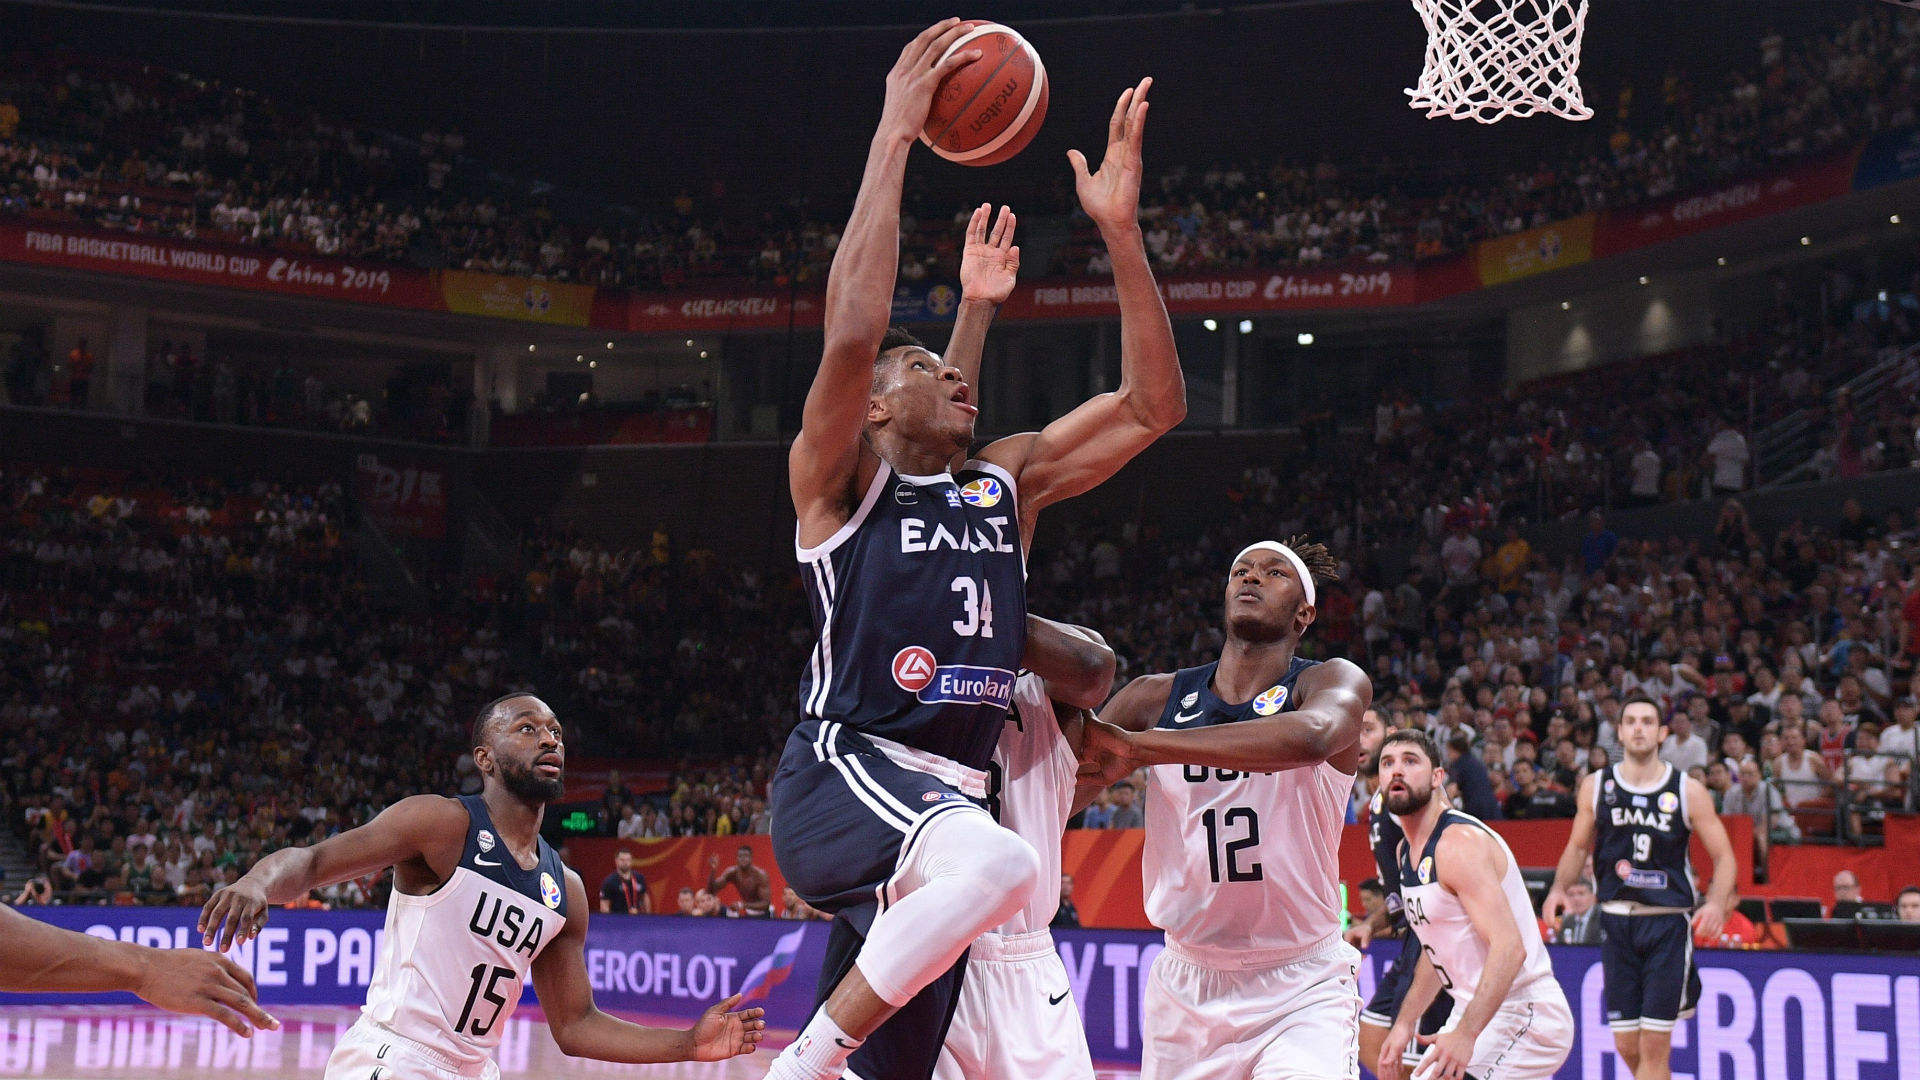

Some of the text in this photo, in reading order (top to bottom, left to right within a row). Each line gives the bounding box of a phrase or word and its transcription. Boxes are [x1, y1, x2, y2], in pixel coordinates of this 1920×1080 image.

[969, 77, 1018, 134] molten
[25, 231, 391, 294] FIBA BASKETBALL WORLD CUP China 2019
[1034, 287, 1068, 305] FIBA
[1168, 281, 1222, 300] WORLD
[1225, 280, 1257, 299] CUP
[1263, 275, 1334, 300] China
[1339, 272, 1392, 296] 2019
[951, 576, 993, 639] 34
[1202, 807, 1264, 883] 12
[1632, 832, 1652, 862] 19
[469, 891, 544, 958] USA
[454, 963, 517, 1036] 15
[588, 949, 737, 1000] EROFLOT
